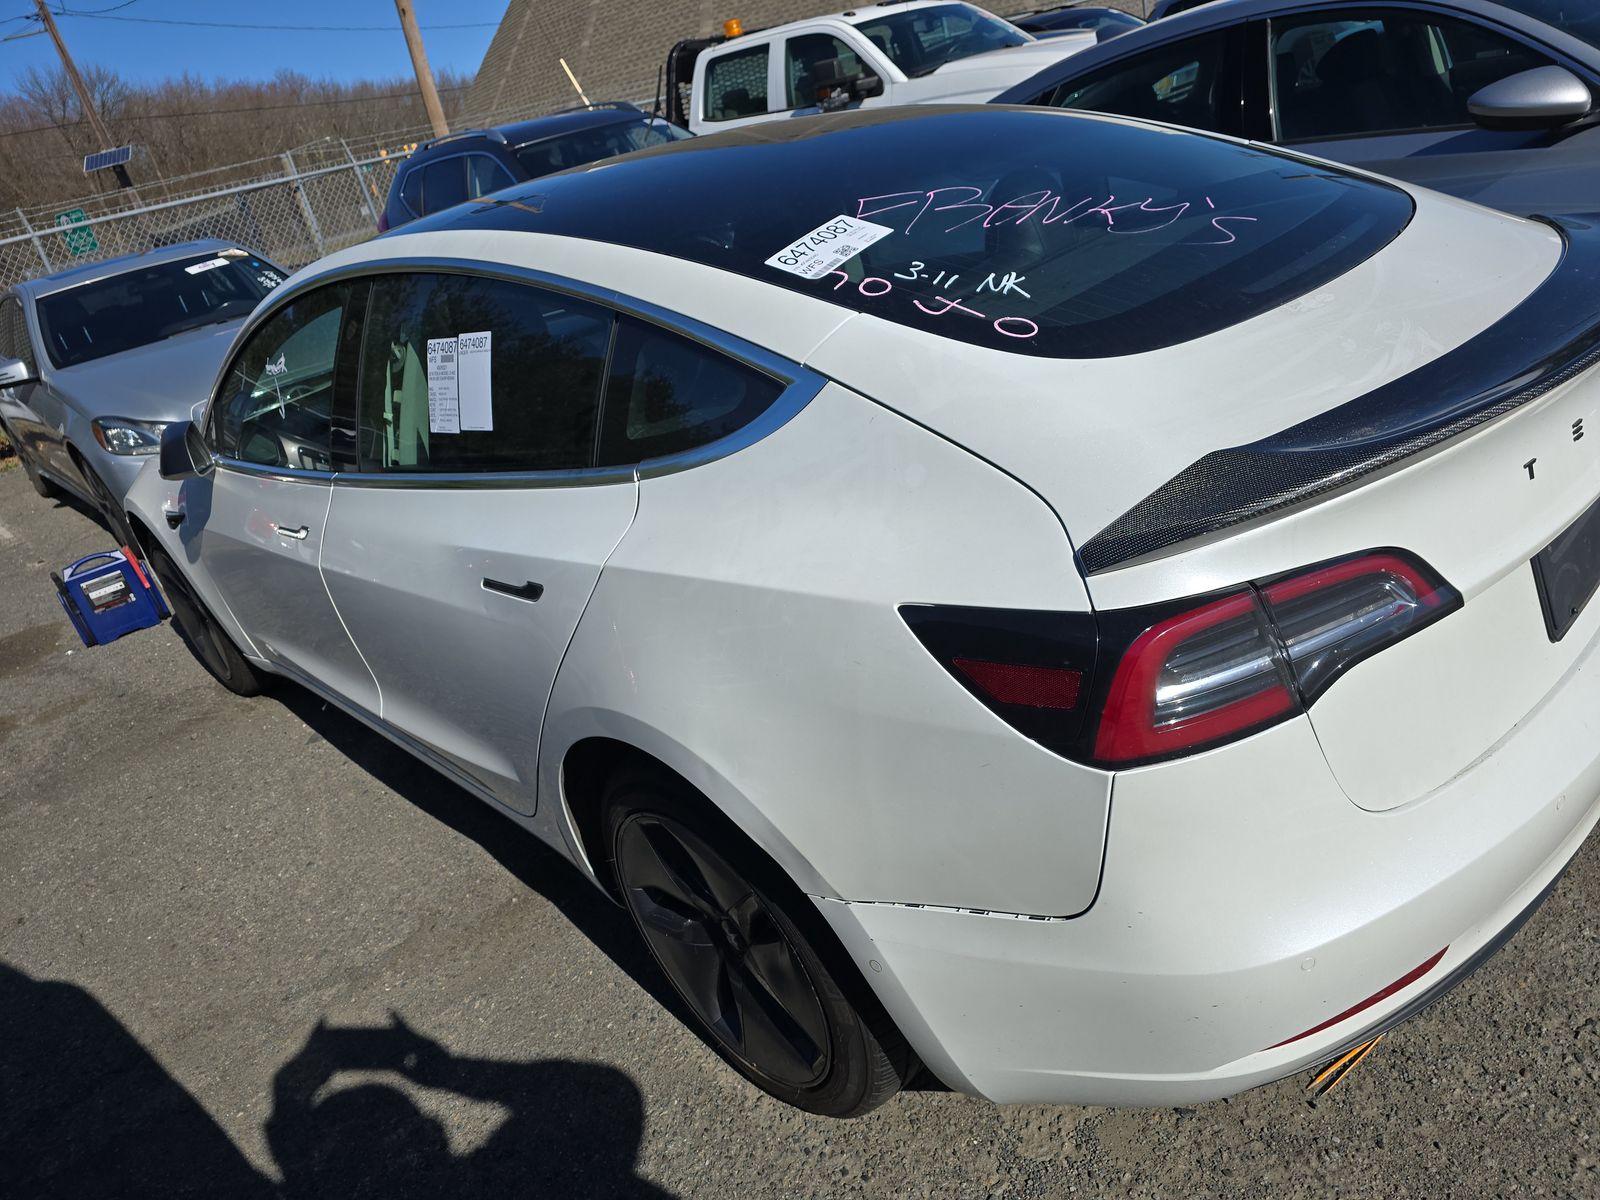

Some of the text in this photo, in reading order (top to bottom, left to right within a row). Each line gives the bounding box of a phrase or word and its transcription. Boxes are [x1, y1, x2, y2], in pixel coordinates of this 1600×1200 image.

[777, 219, 854, 266] 6474087
[799, 260, 824, 275] WFS
[893, 261, 960, 289] 3-11
[428, 340, 458, 355] 6474087
[460, 336, 488, 351] 6474087
